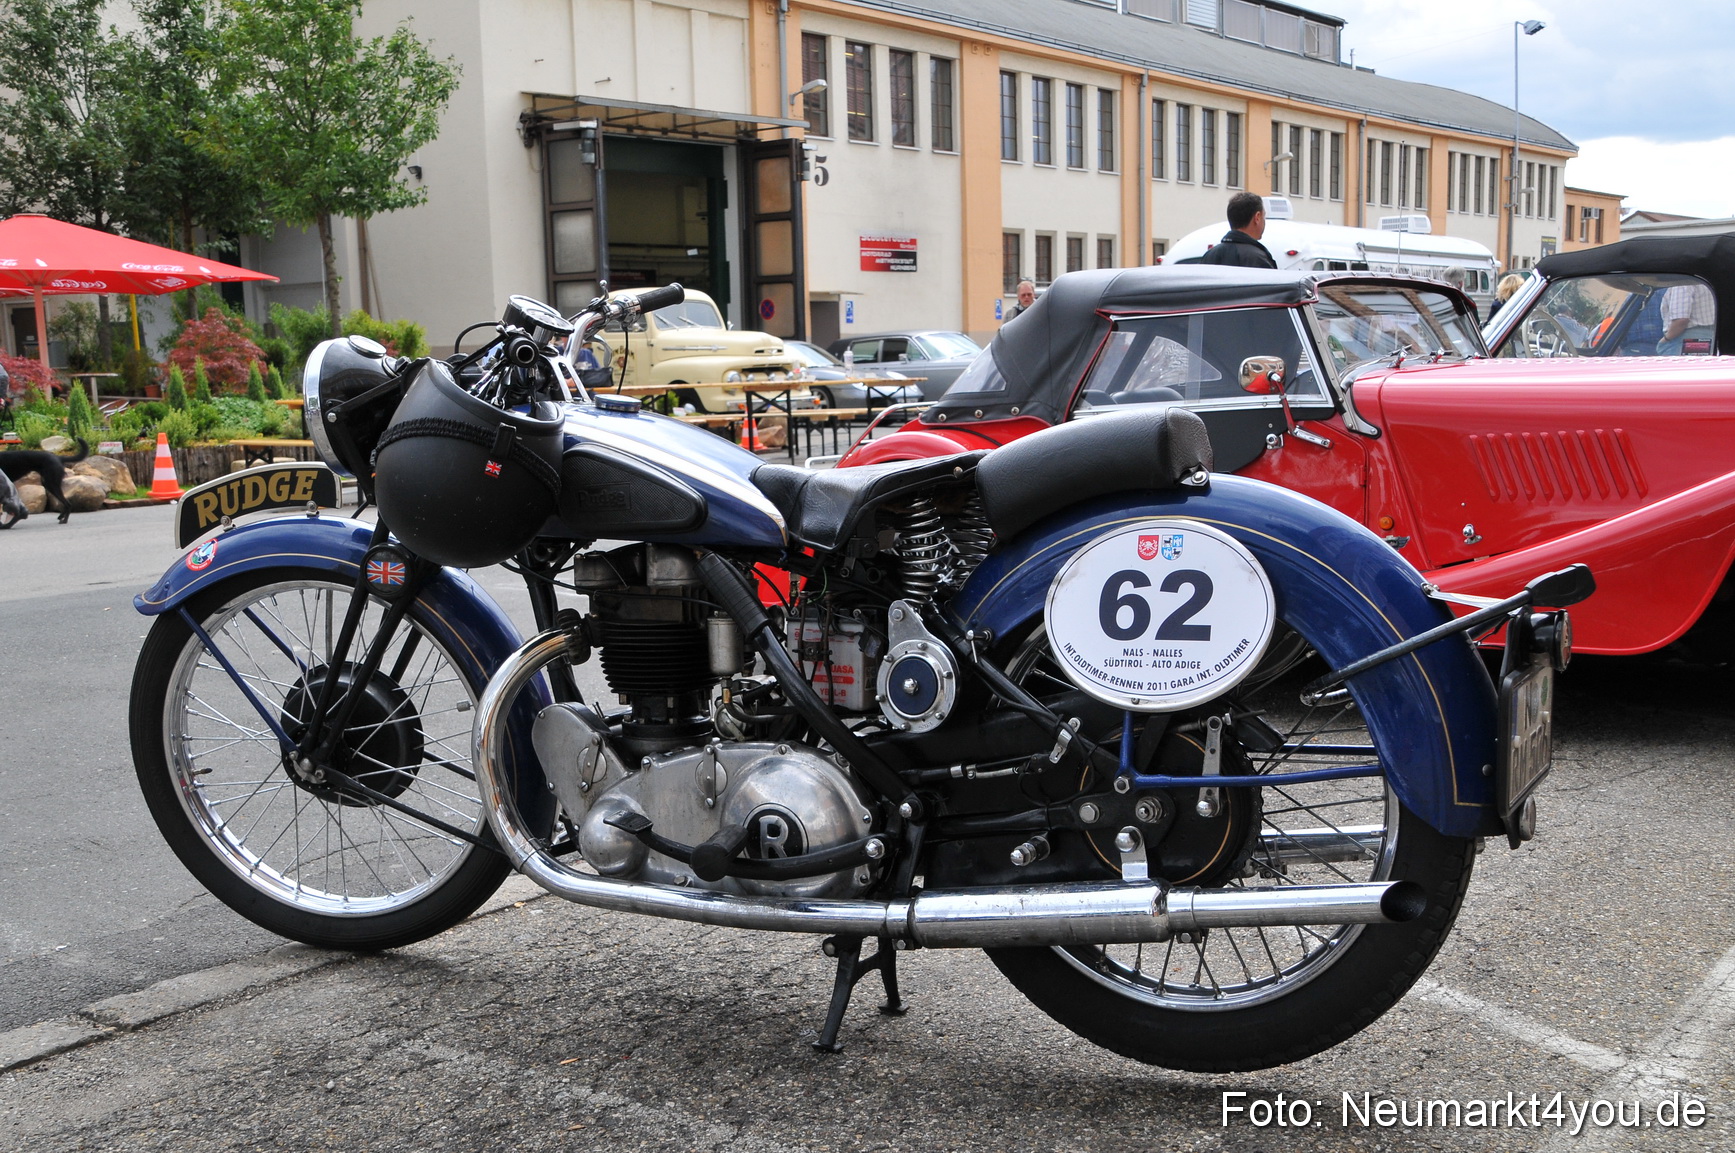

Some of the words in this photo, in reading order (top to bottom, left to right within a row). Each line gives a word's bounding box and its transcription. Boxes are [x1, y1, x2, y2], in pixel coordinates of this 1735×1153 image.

[814, 155, 829, 187] 5
[194, 470, 318, 528] RUDGE
[1099, 569, 1214, 641] 62
[1104, 656, 1143, 668] SÜDTIROL
[1152, 660, 1172, 669] ALTO
[1174, 660, 1201, 669] ADIGE
[1122, 648, 1144, 657] NALS
[1152, 648, 1183, 658] NALLES
[1146, 682, 1168, 691] 2011
[1170, 676, 1195, 689] GARA
[1214, 638, 1251, 673] OLDTIMER
[758, 815, 788, 858] R
